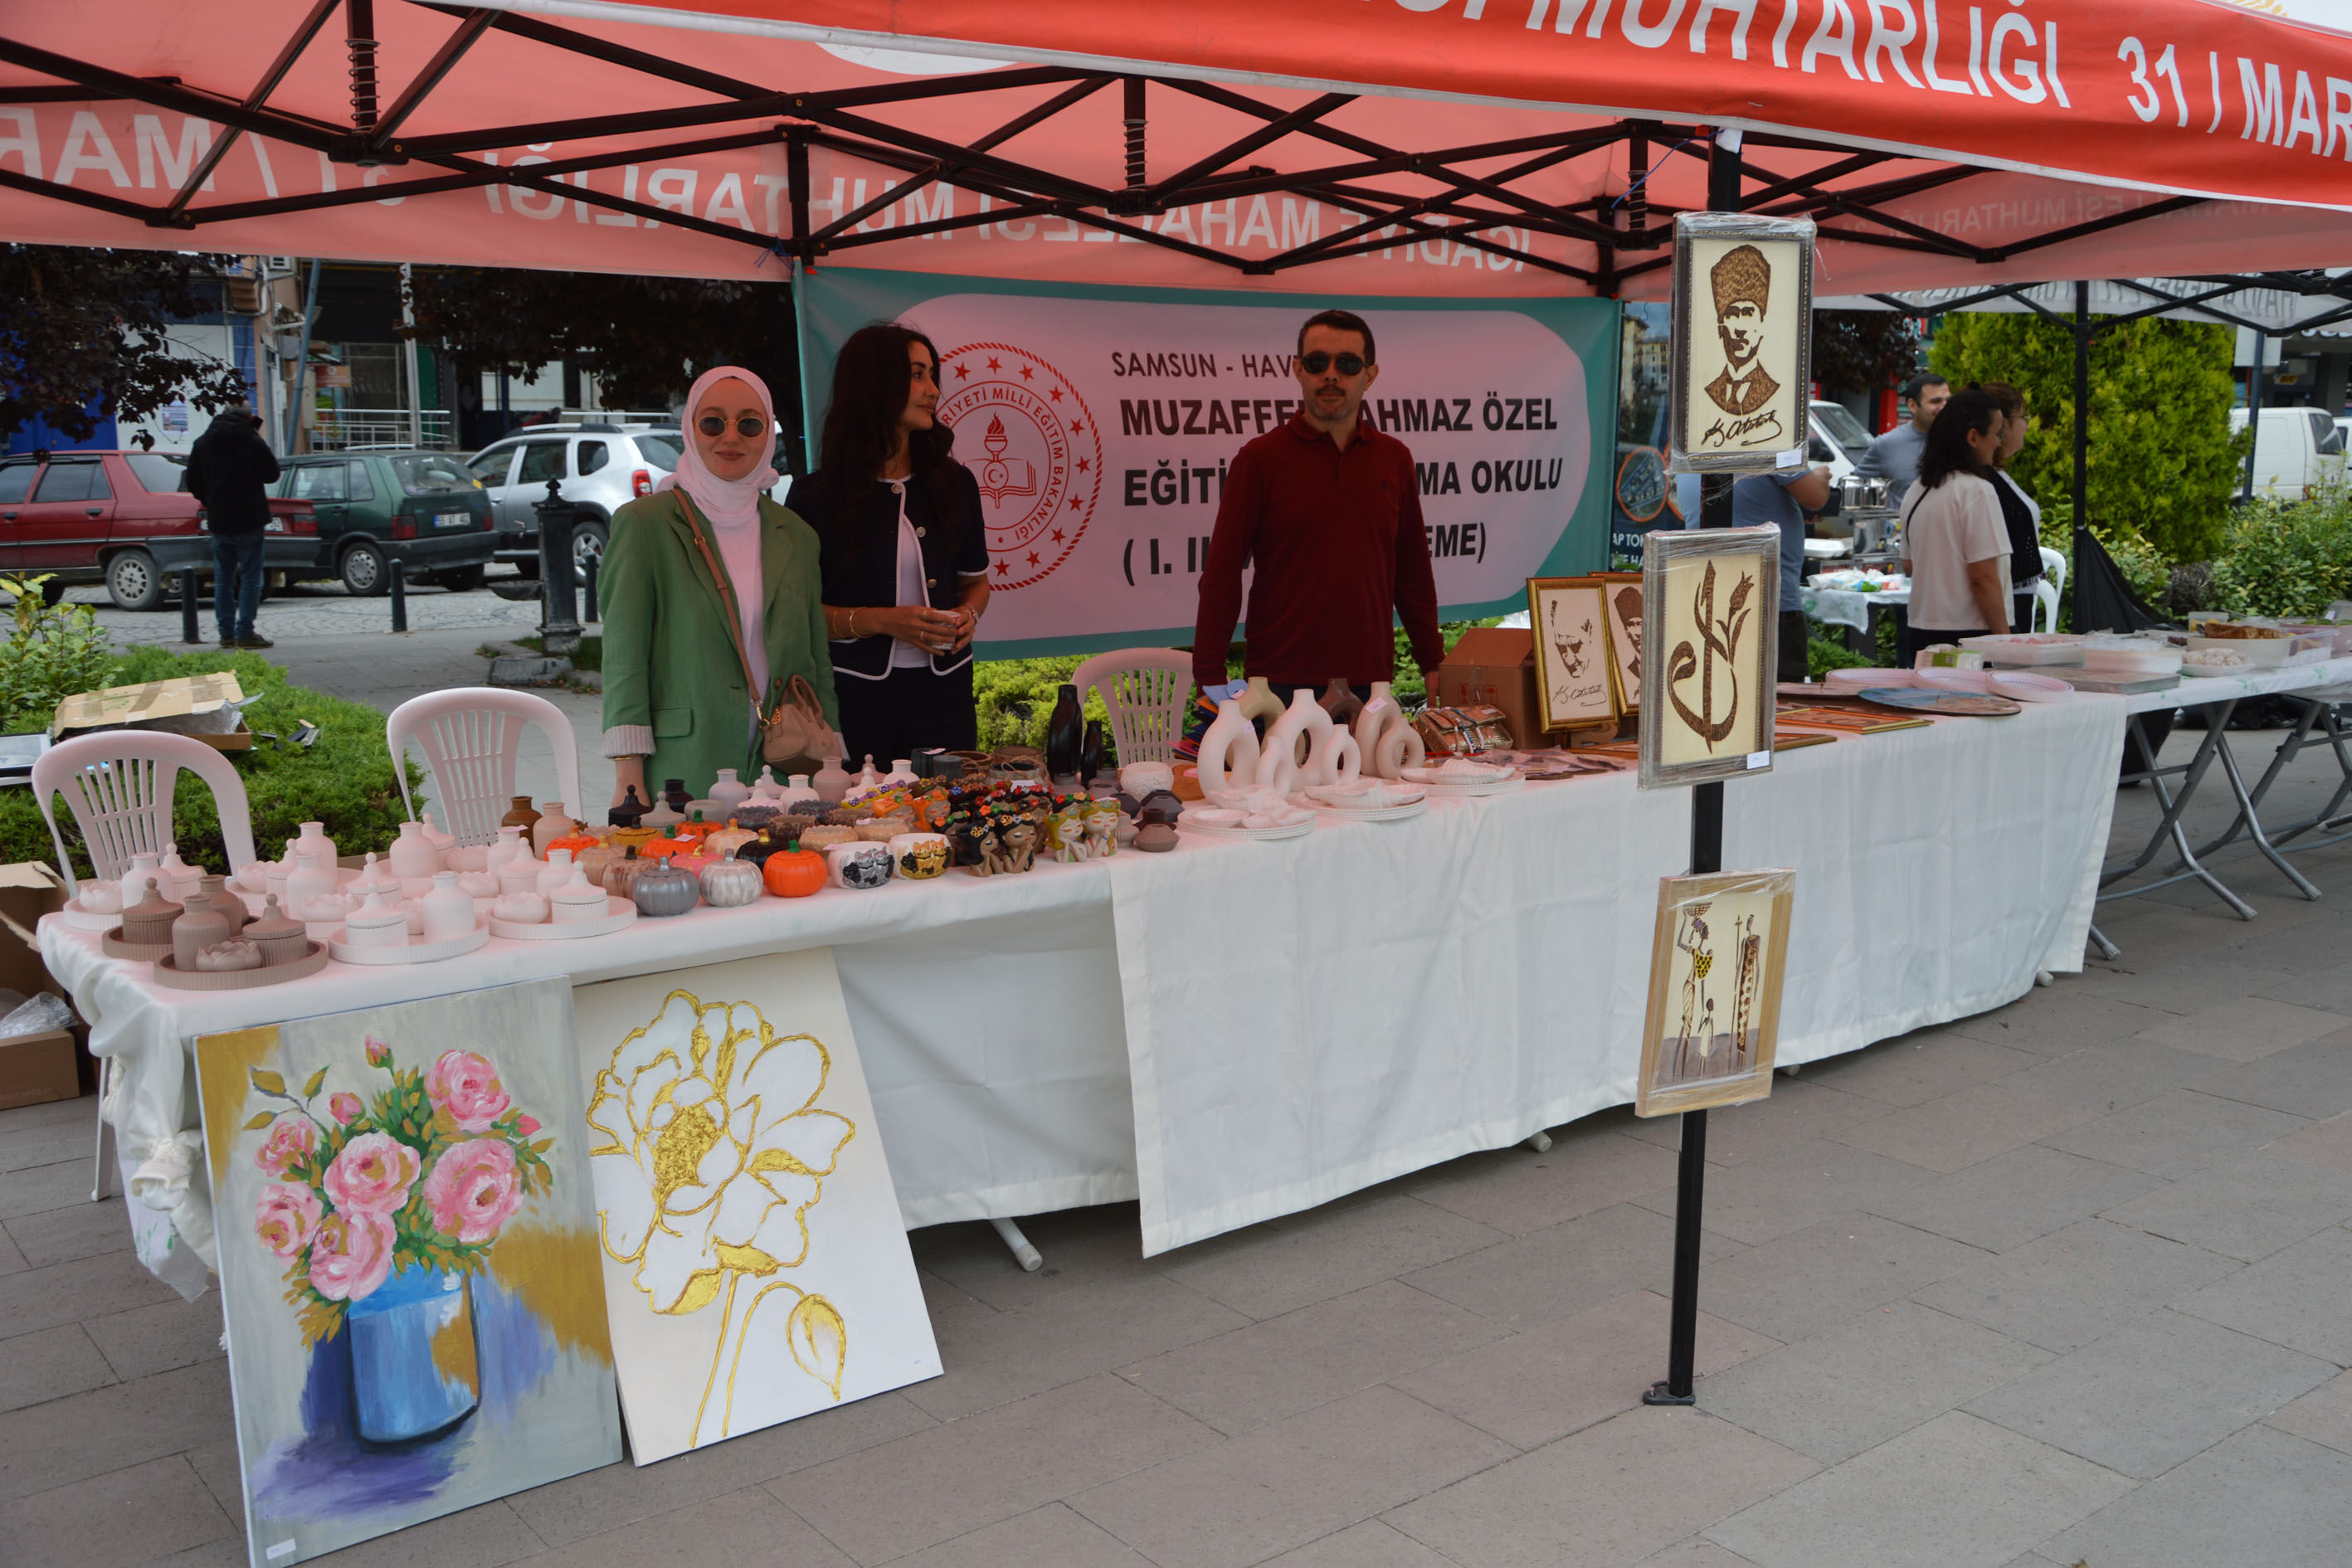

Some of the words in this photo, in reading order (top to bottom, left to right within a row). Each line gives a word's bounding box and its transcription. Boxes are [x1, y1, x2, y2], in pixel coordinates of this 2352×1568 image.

[2117, 36, 2189, 128] 31
[1111, 351, 1218, 378] SAMSUN
[1241, 354, 1298, 378] HAV
[941, 386, 988, 426] RİYETİ
[1119, 399, 1305, 436] MUZAFFE
[1358, 398, 1473, 433] AHMAZ
[1482, 391, 1558, 431] ÖZEL
[1033, 407, 1064, 460] EĞİTİM
[1014, 465, 1064, 541] BAKANLIĞI
[1124, 458, 1227, 507] EĞİTİ
[1415, 461, 1462, 496] MA
[1470, 457, 1564, 494] OKULU
[1424, 521, 1487, 564] EME)
